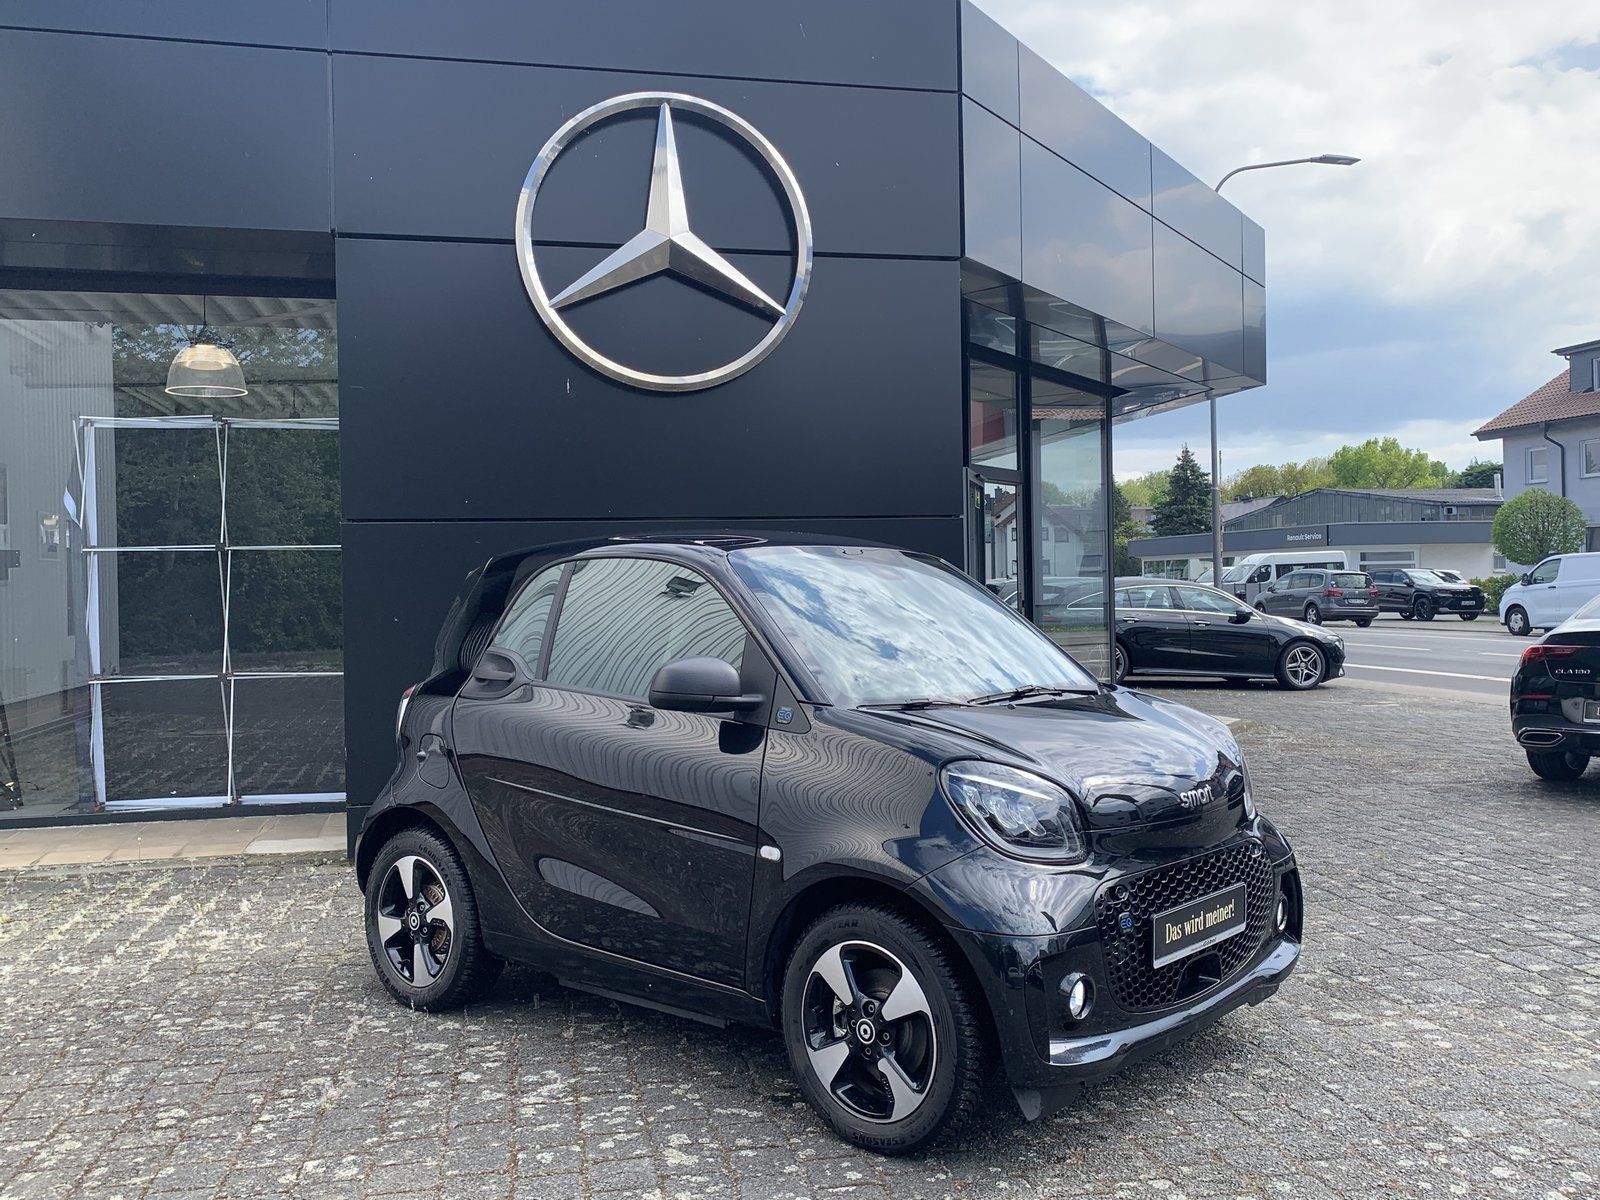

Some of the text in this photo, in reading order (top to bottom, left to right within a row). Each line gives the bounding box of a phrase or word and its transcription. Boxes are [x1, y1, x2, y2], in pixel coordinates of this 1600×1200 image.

[1286, 532, 1322, 541] Renault Service
[777, 710, 792, 720] EQ
[1180, 784, 1215, 808] smart
[1120, 917, 1132, 928] EQ
[1165, 898, 1235, 944] Das wird meiner!
